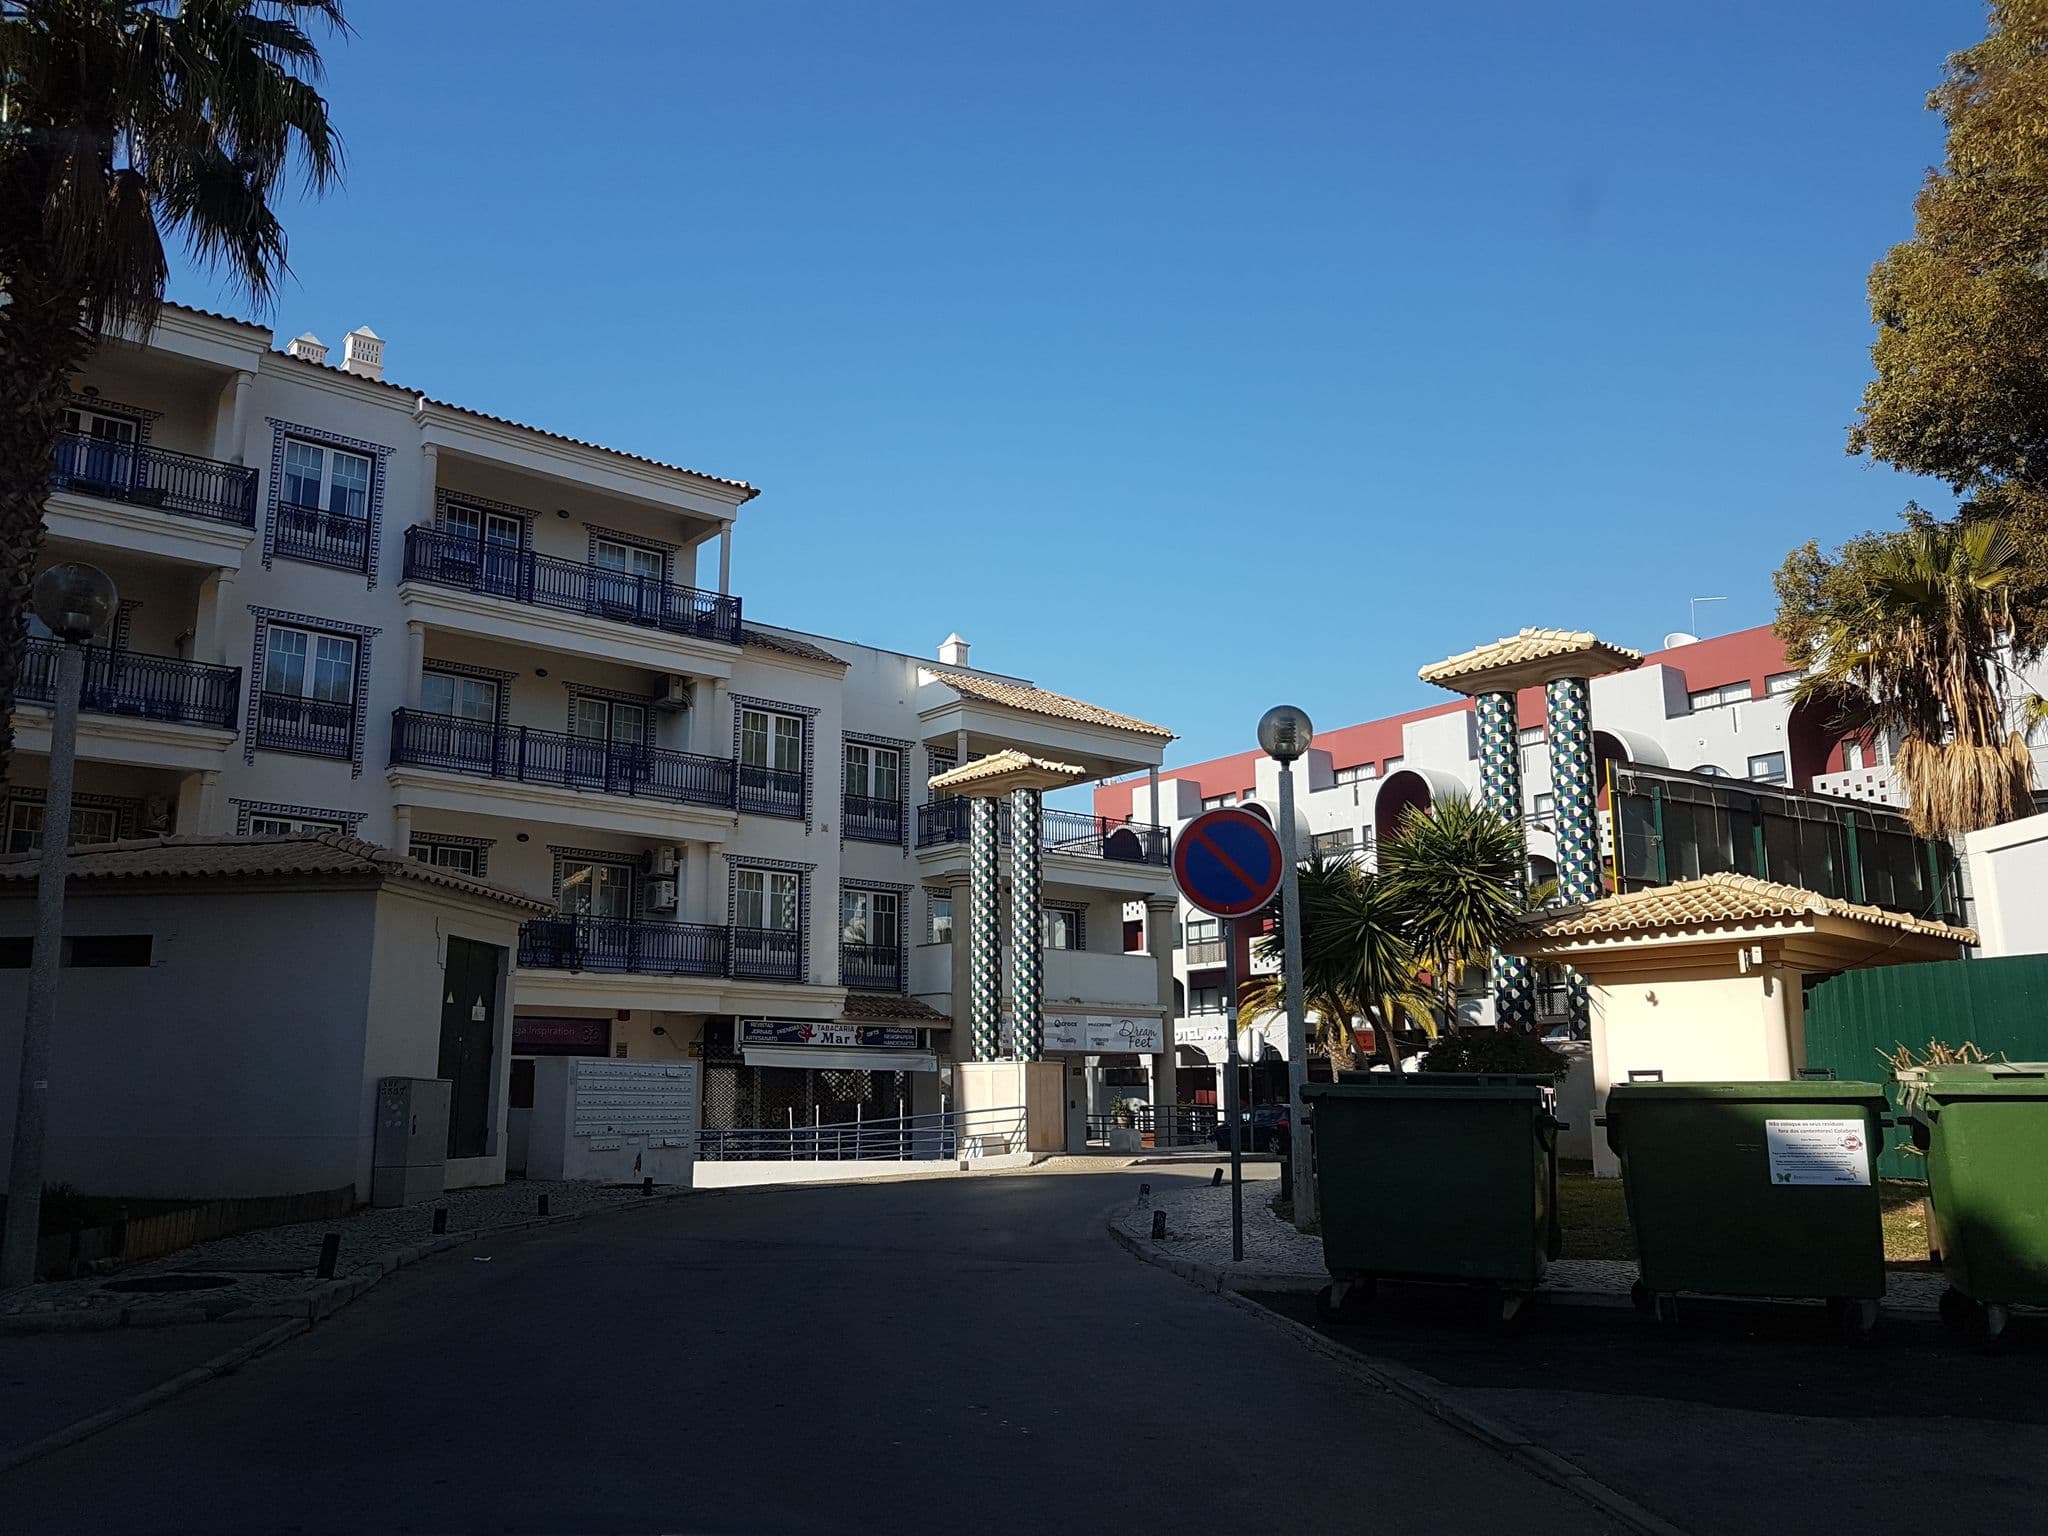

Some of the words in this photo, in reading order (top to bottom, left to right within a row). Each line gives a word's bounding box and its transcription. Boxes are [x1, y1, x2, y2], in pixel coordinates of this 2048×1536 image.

[817, 1024, 854, 1032] TABACARIA
[1119, 1019, 1157, 1037] Dream
[820, 1032, 851, 1044] Mar
[1129, 1035, 1153, 1049] Feet
